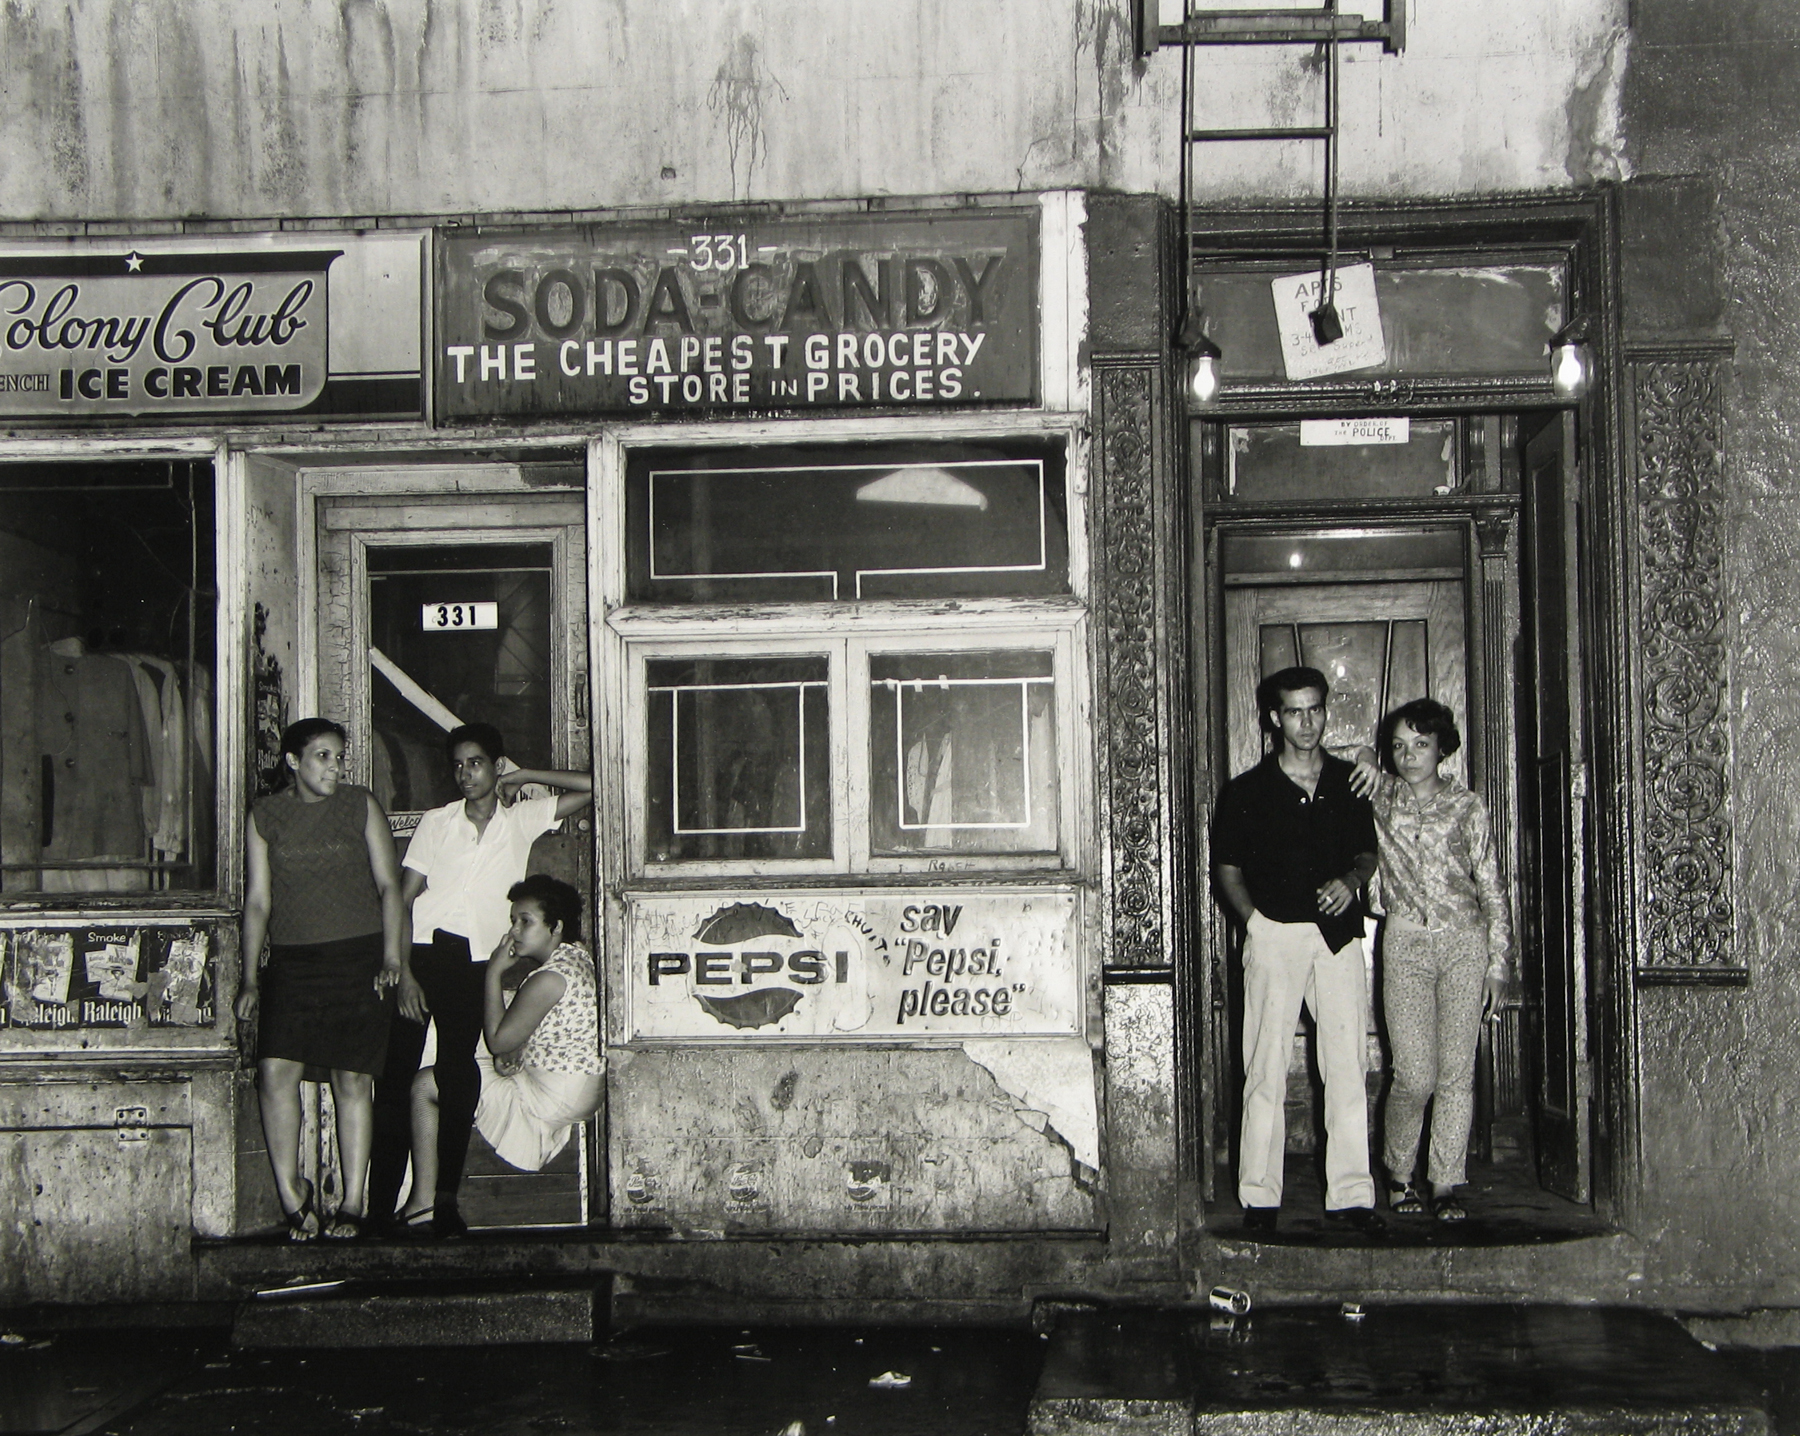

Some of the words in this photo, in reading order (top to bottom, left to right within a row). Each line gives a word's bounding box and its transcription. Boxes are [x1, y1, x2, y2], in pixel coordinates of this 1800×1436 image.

[153, 276, 314, 364] Club
[447, 343, 536, 383] THE
[804, 332, 986, 370] GROCERY
[60, 368, 129, 400] ICE
[144, 364, 301, 398] CREAM
[629, 373, 751, 405] STORE
[771, 378, 798, 397] IN
[1353, 427, 1390, 436] POLICE
[437, 605, 476, 626] 331
[901, 904, 963, 936] say
[88, 931, 127, 942] Smoke
[648, 951, 849, 984] PEPSI
[83, 1000, 142, 1024] Raleigh
